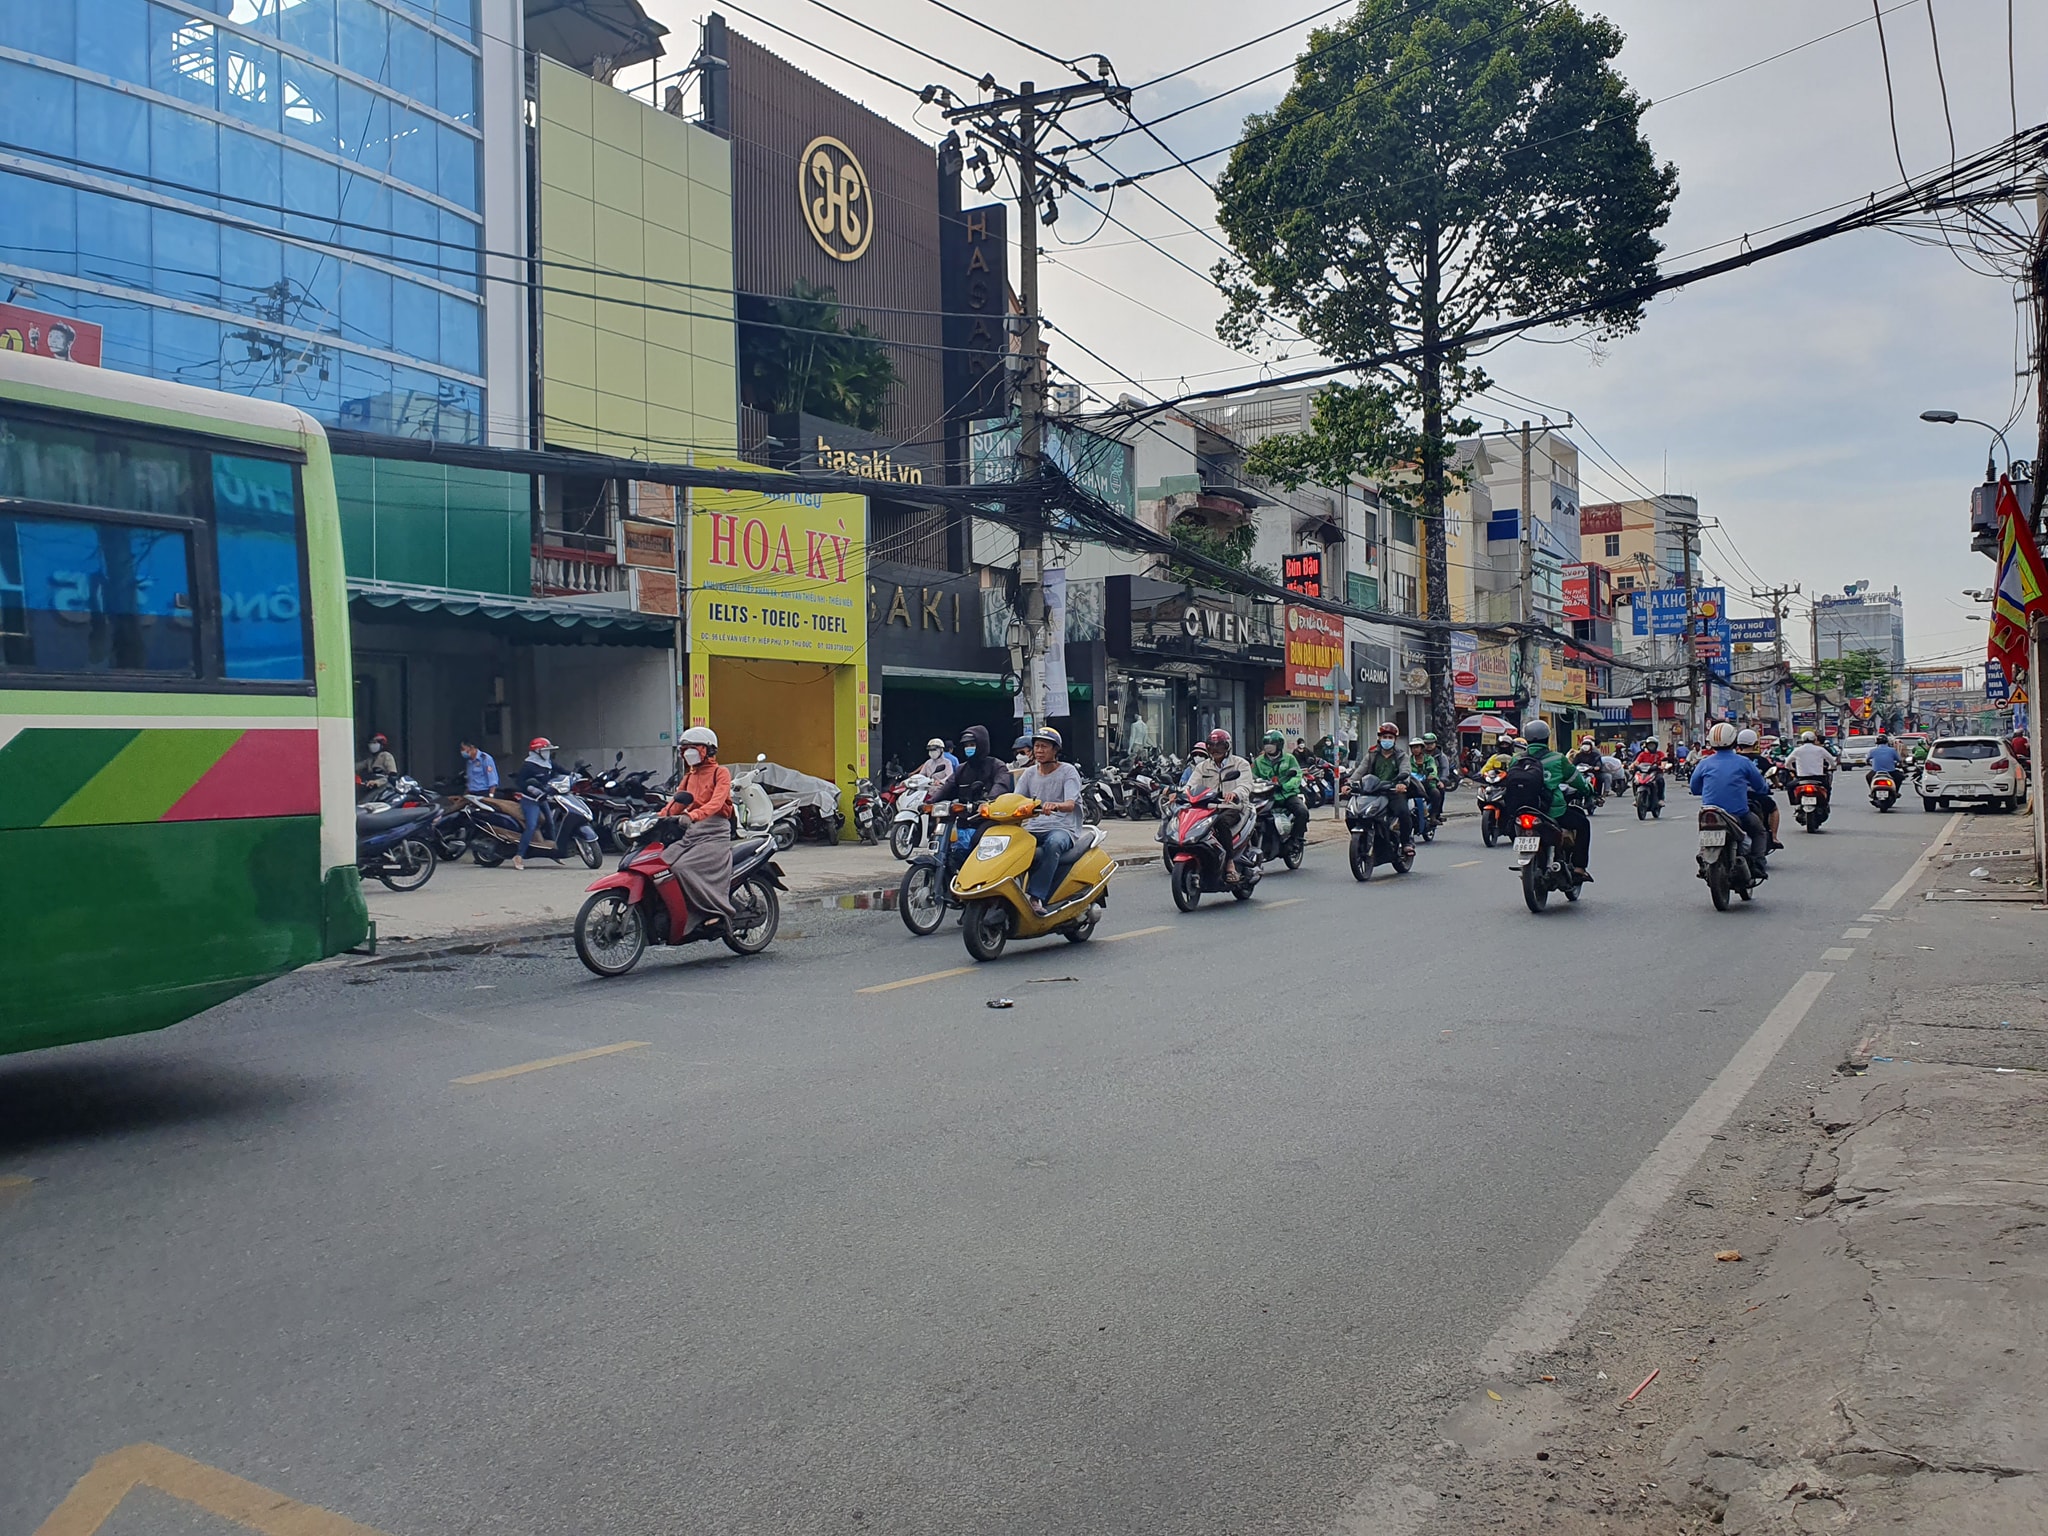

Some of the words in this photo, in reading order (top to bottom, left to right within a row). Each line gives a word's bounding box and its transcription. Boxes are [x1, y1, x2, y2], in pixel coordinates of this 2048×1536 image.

[817, 435, 922, 485] hasaki.vn
[709, 511, 796, 576] HOA
[805, 518, 852, 583] KỲ
[709, 602, 748, 624] IELTS
[762, 608, 800, 629] TOEIC
[812, 614, 847, 634] TOEFL
[1185, 606, 1249, 645] OWEN
